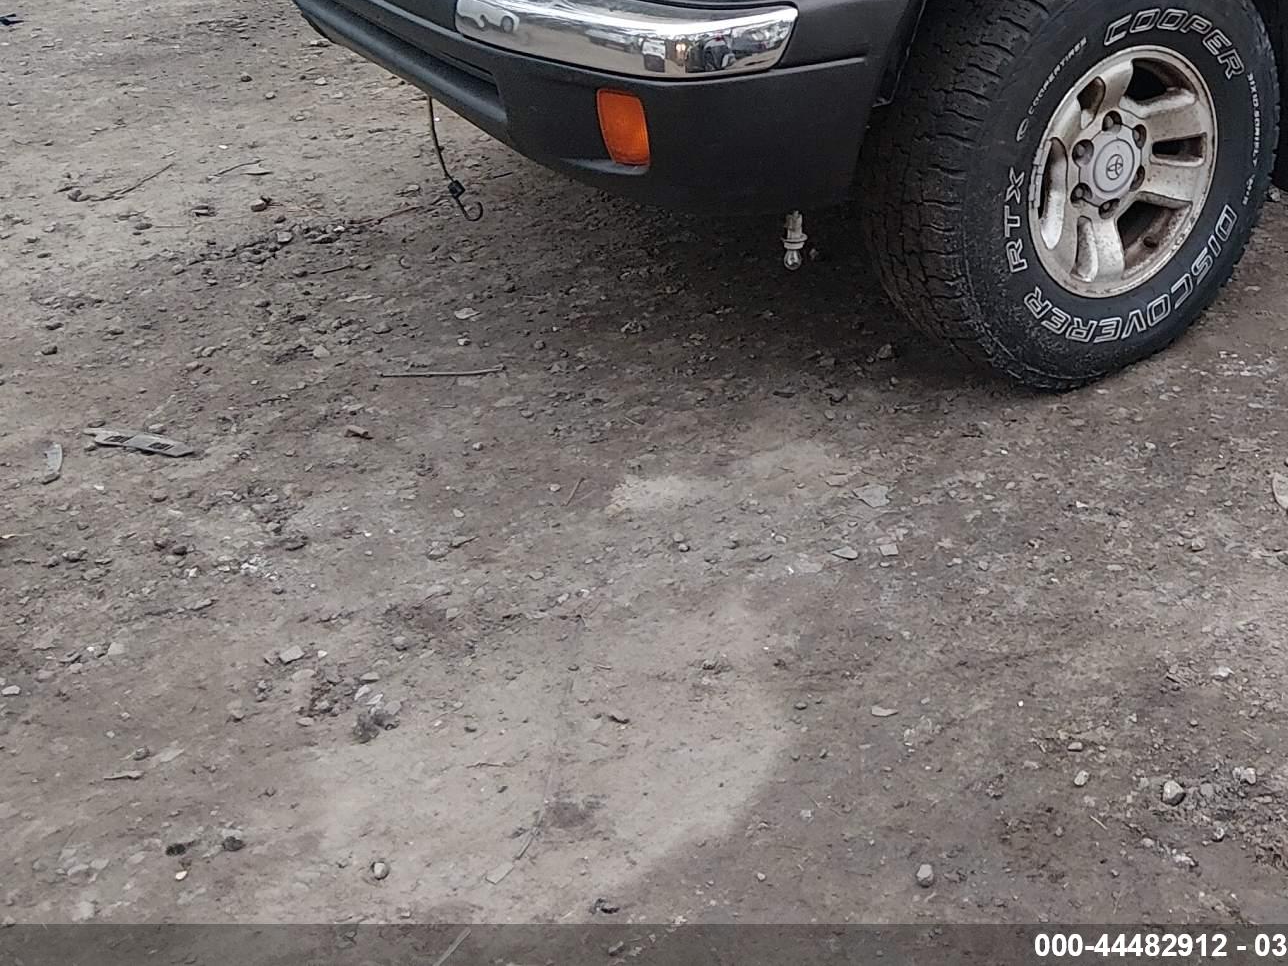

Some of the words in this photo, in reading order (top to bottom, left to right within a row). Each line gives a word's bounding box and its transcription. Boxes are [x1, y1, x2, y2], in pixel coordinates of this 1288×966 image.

[1103, 8, 1245, 80] COOPER
[1004, 166, 1029, 273] RTX
[1023, 204, 1238, 344] DISCOVERER
